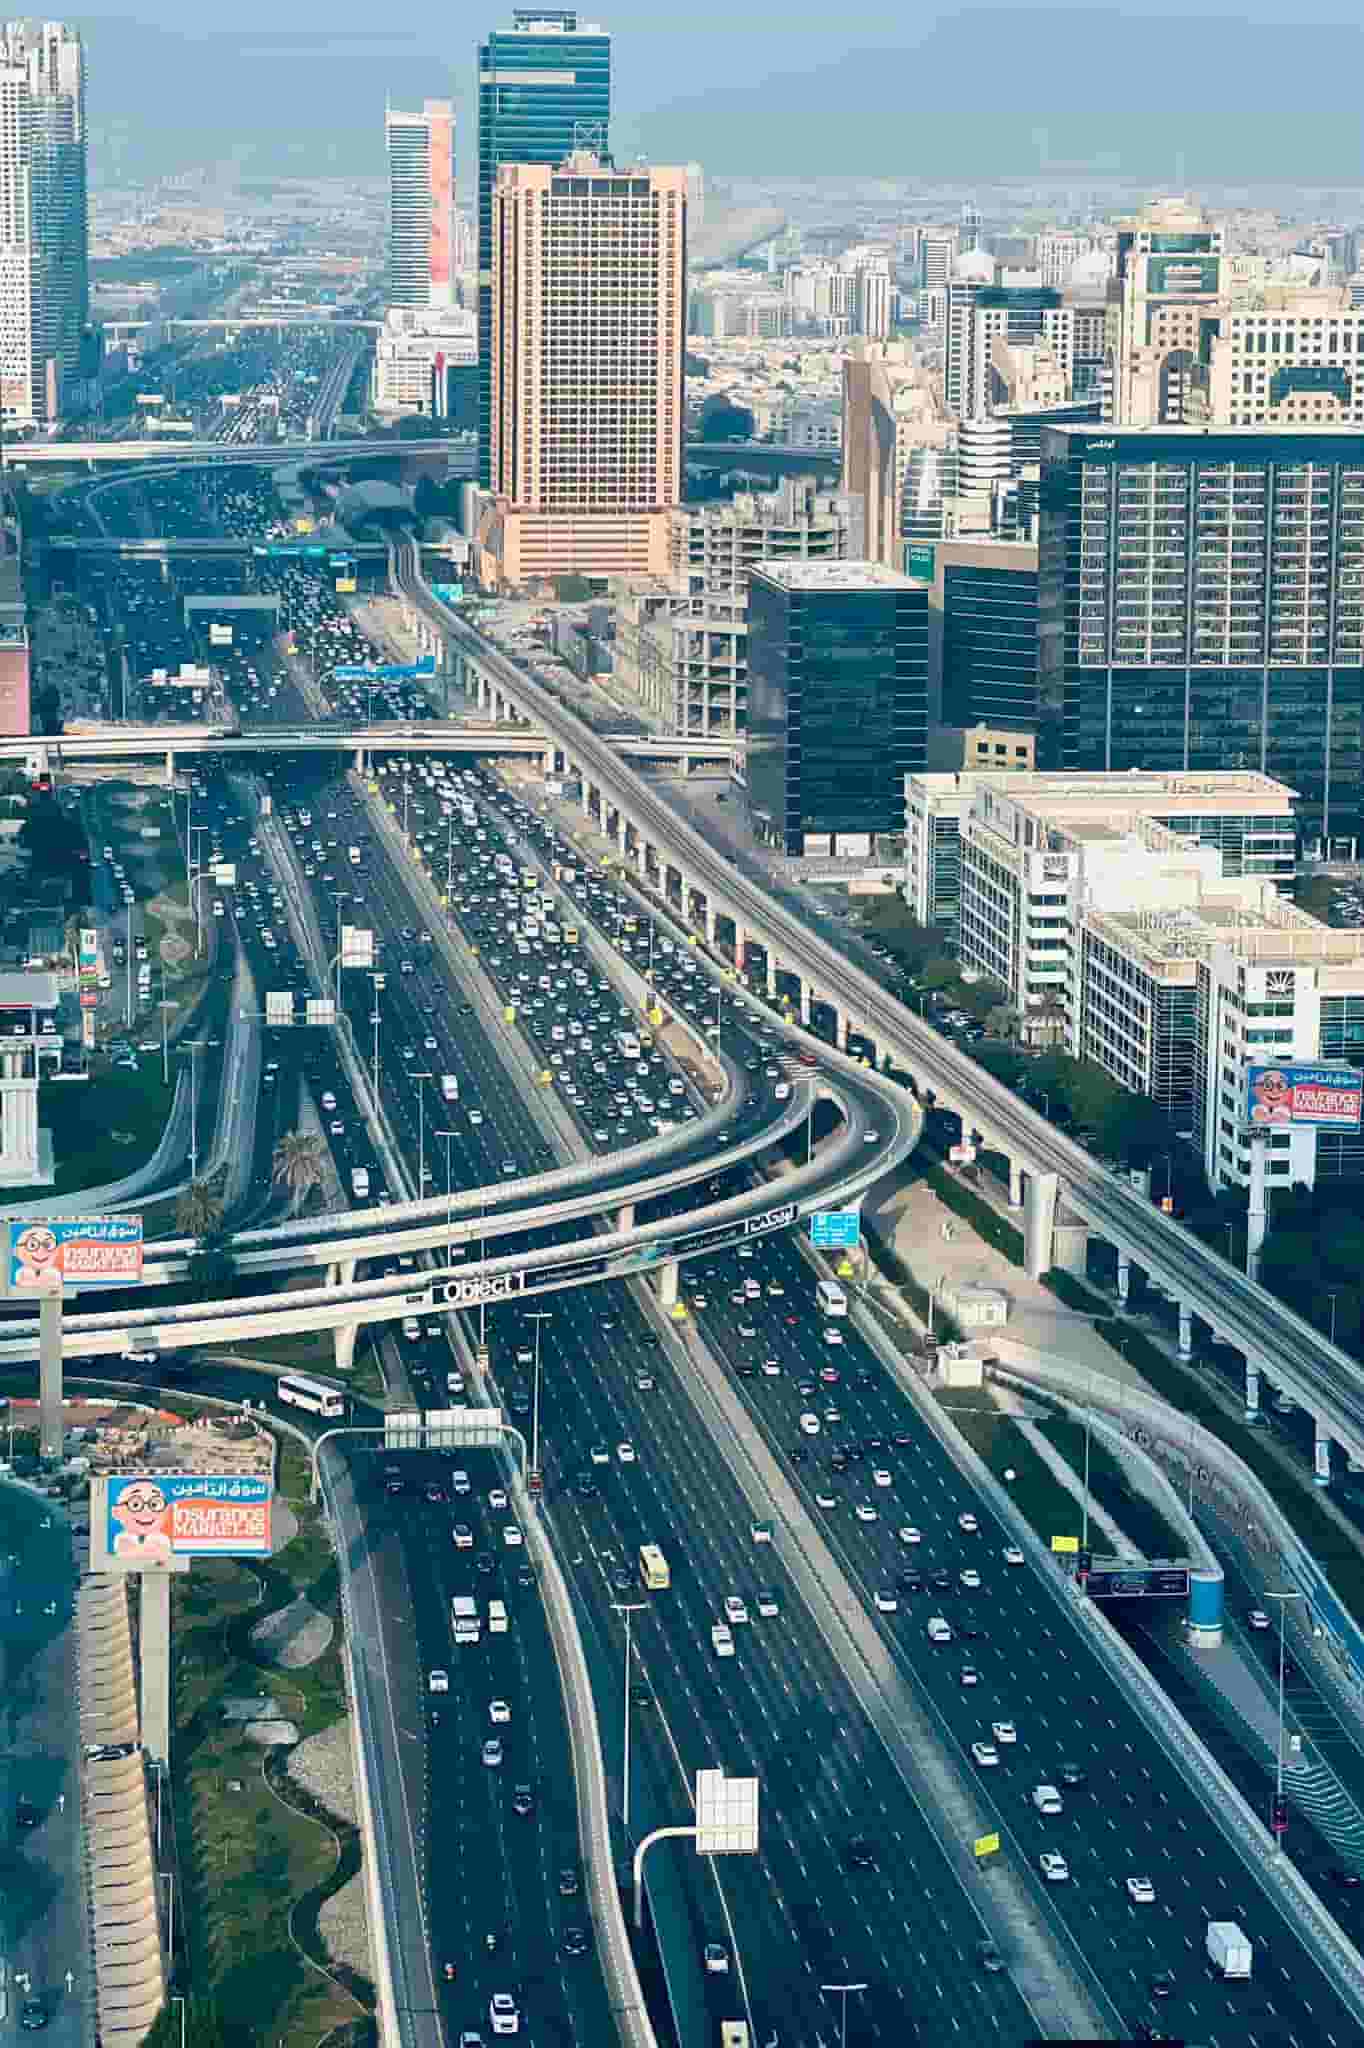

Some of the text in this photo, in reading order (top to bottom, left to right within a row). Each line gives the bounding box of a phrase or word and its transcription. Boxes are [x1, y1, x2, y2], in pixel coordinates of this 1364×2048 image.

[445, 1273, 512, 1301] Object
[231, 1480, 265, 1497] سوق
[174, 1507, 265, 1521] Insurance
